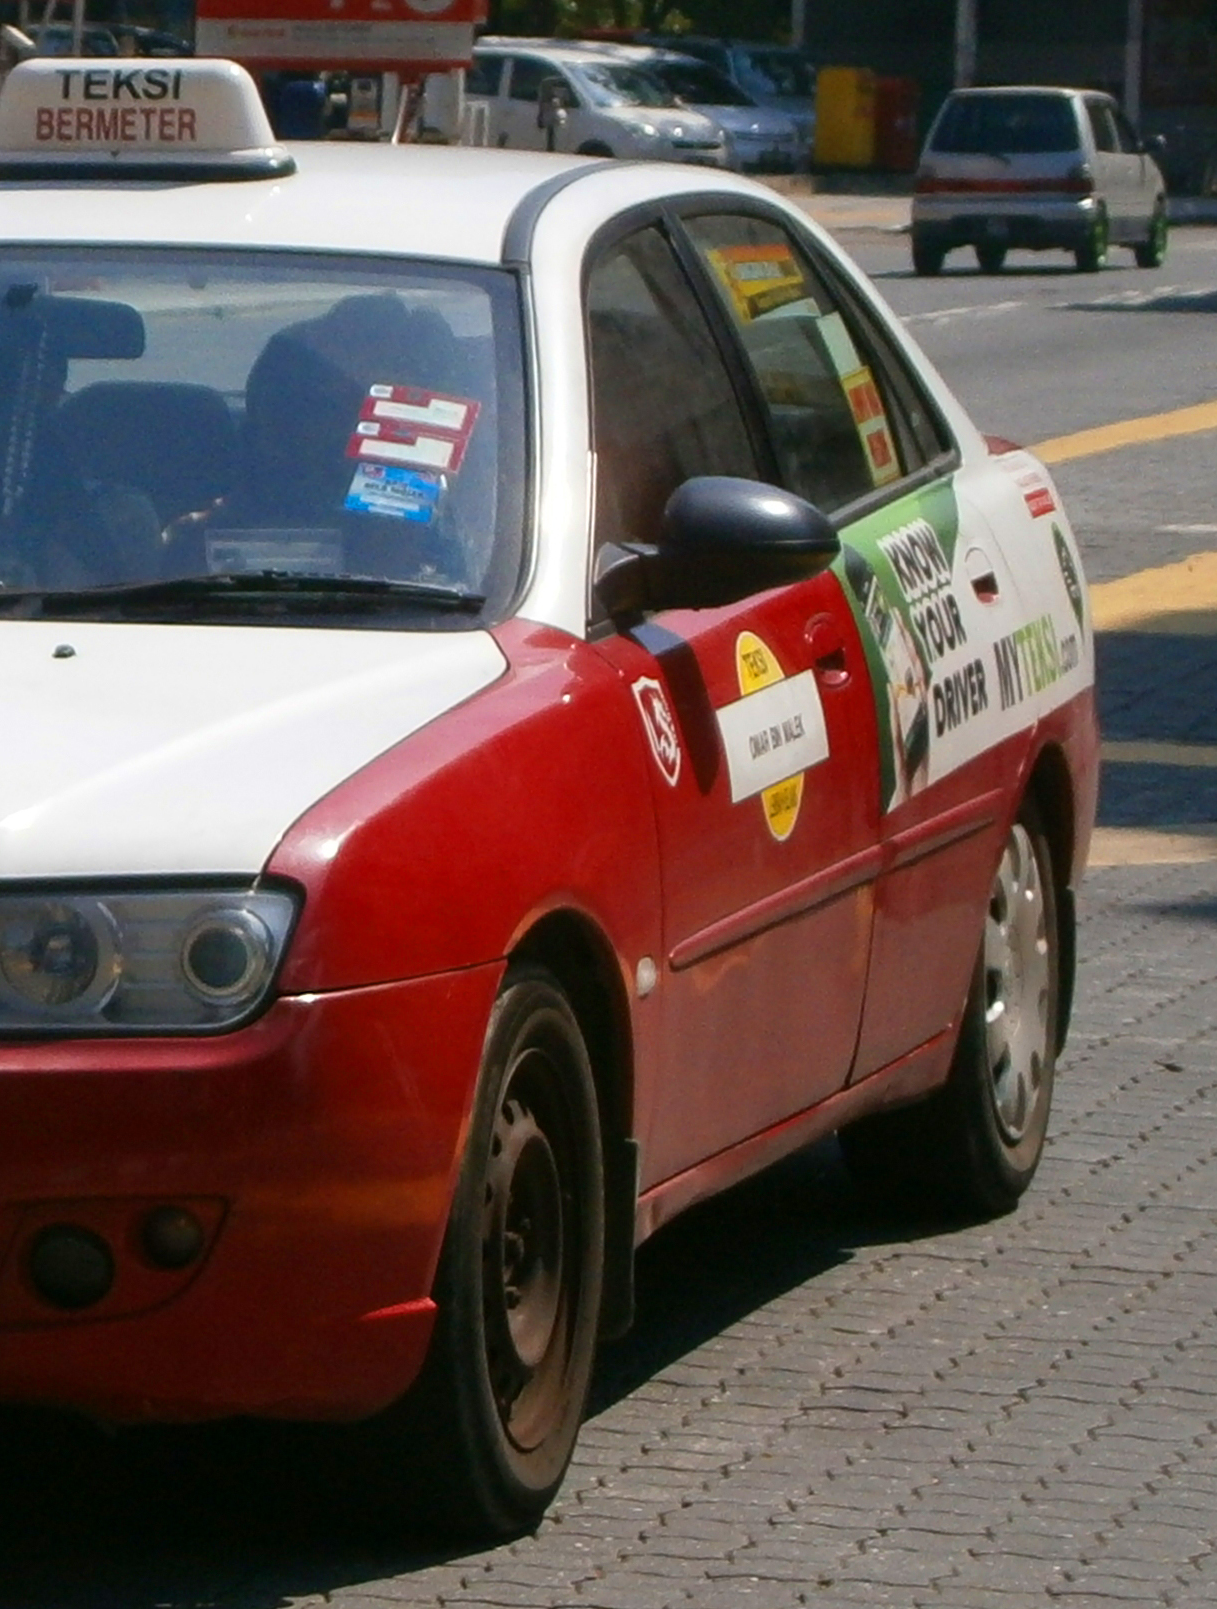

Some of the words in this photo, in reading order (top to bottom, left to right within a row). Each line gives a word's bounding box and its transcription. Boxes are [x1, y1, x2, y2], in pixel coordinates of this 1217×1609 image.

[55, 69, 182, 100] TEKSI
[36, 107, 196, 141] BERMETER
[884, 530, 951, 592] KNOW
[913, 593, 968, 663] YOUR
[932, 658, 989, 738] DRIVER
